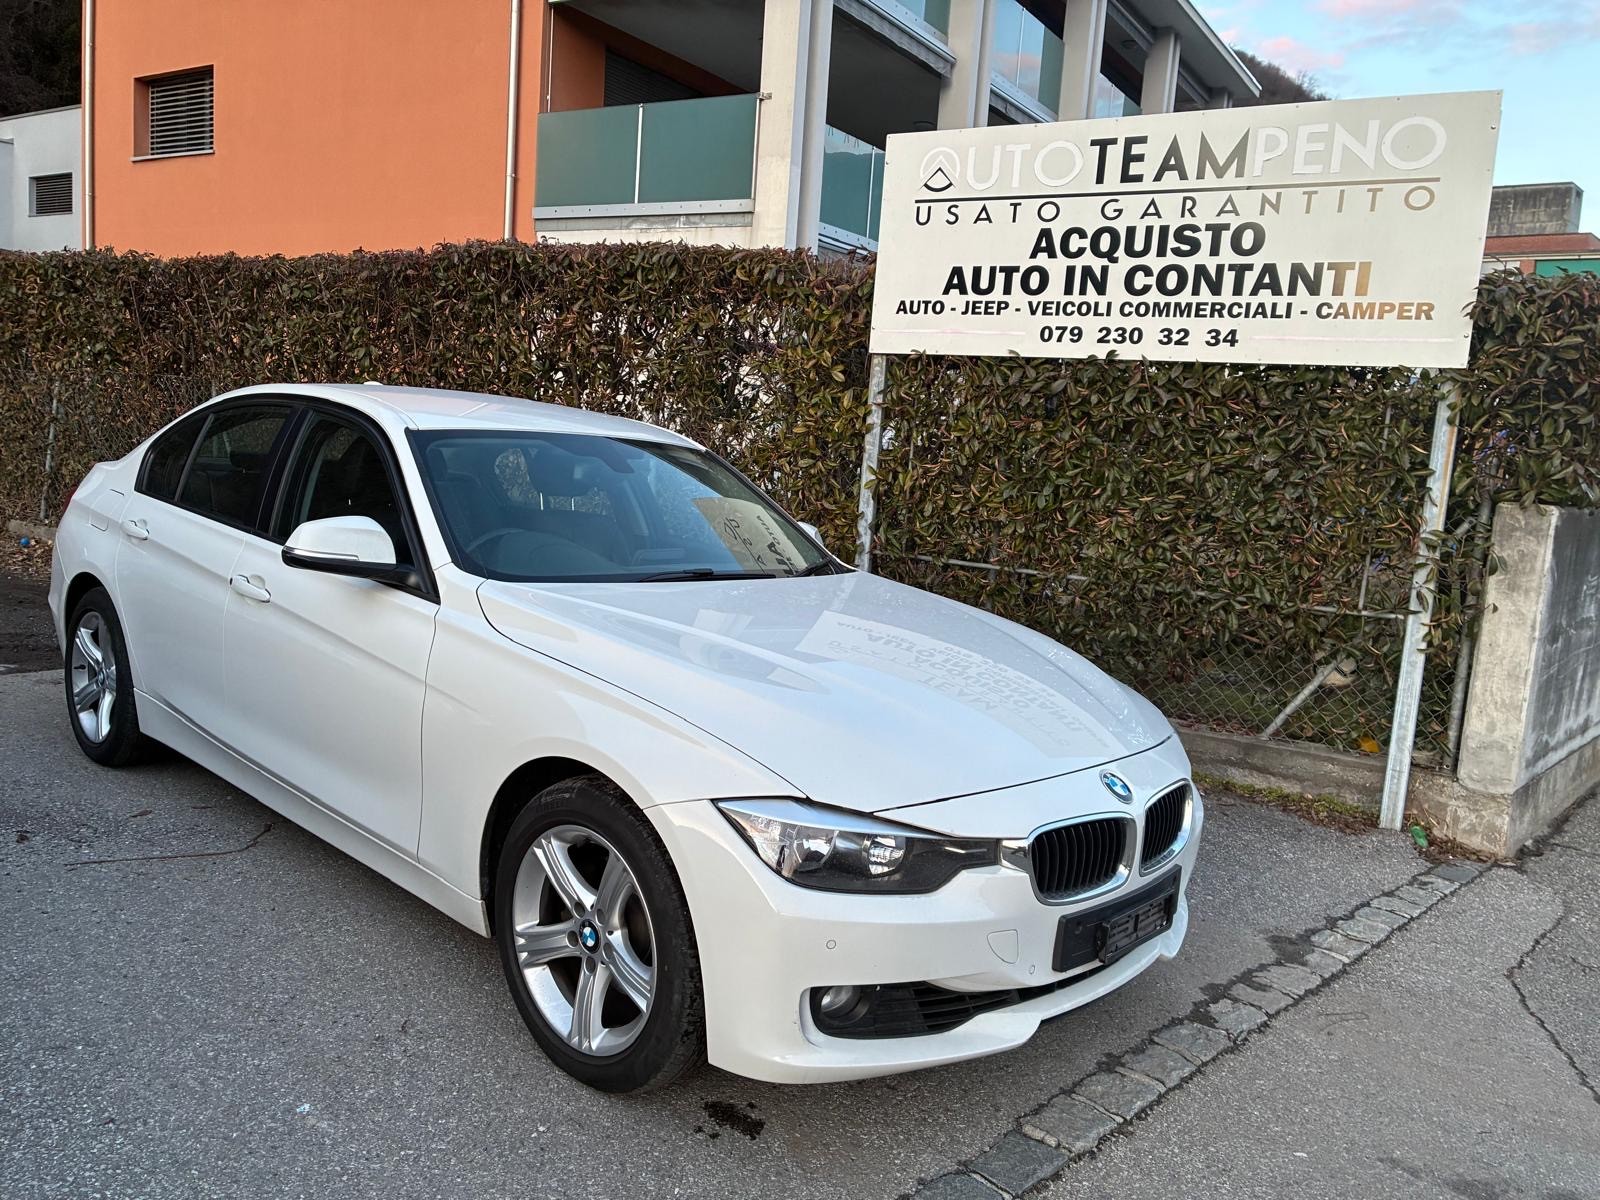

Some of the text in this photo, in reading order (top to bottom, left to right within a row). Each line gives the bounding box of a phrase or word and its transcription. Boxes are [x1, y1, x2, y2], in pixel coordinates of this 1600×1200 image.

[915, 185, 1436, 226] USATO GARANTITO
[1029, 222, 1266, 263] ACQUISTO
[942, 261, 1373, 297] AUTO IN CONTANTI
[896, 299, 945, 316] AUTO
[961, 300, 1010, 316] JEEP
[1027, 300, 1112, 317] VEICOLI
[1119, 301, 1293, 319] COMMERCIALI
[1316, 302, 1435, 321] CAMPER
[1039, 326, 1239, 347] 079 230 32 34
